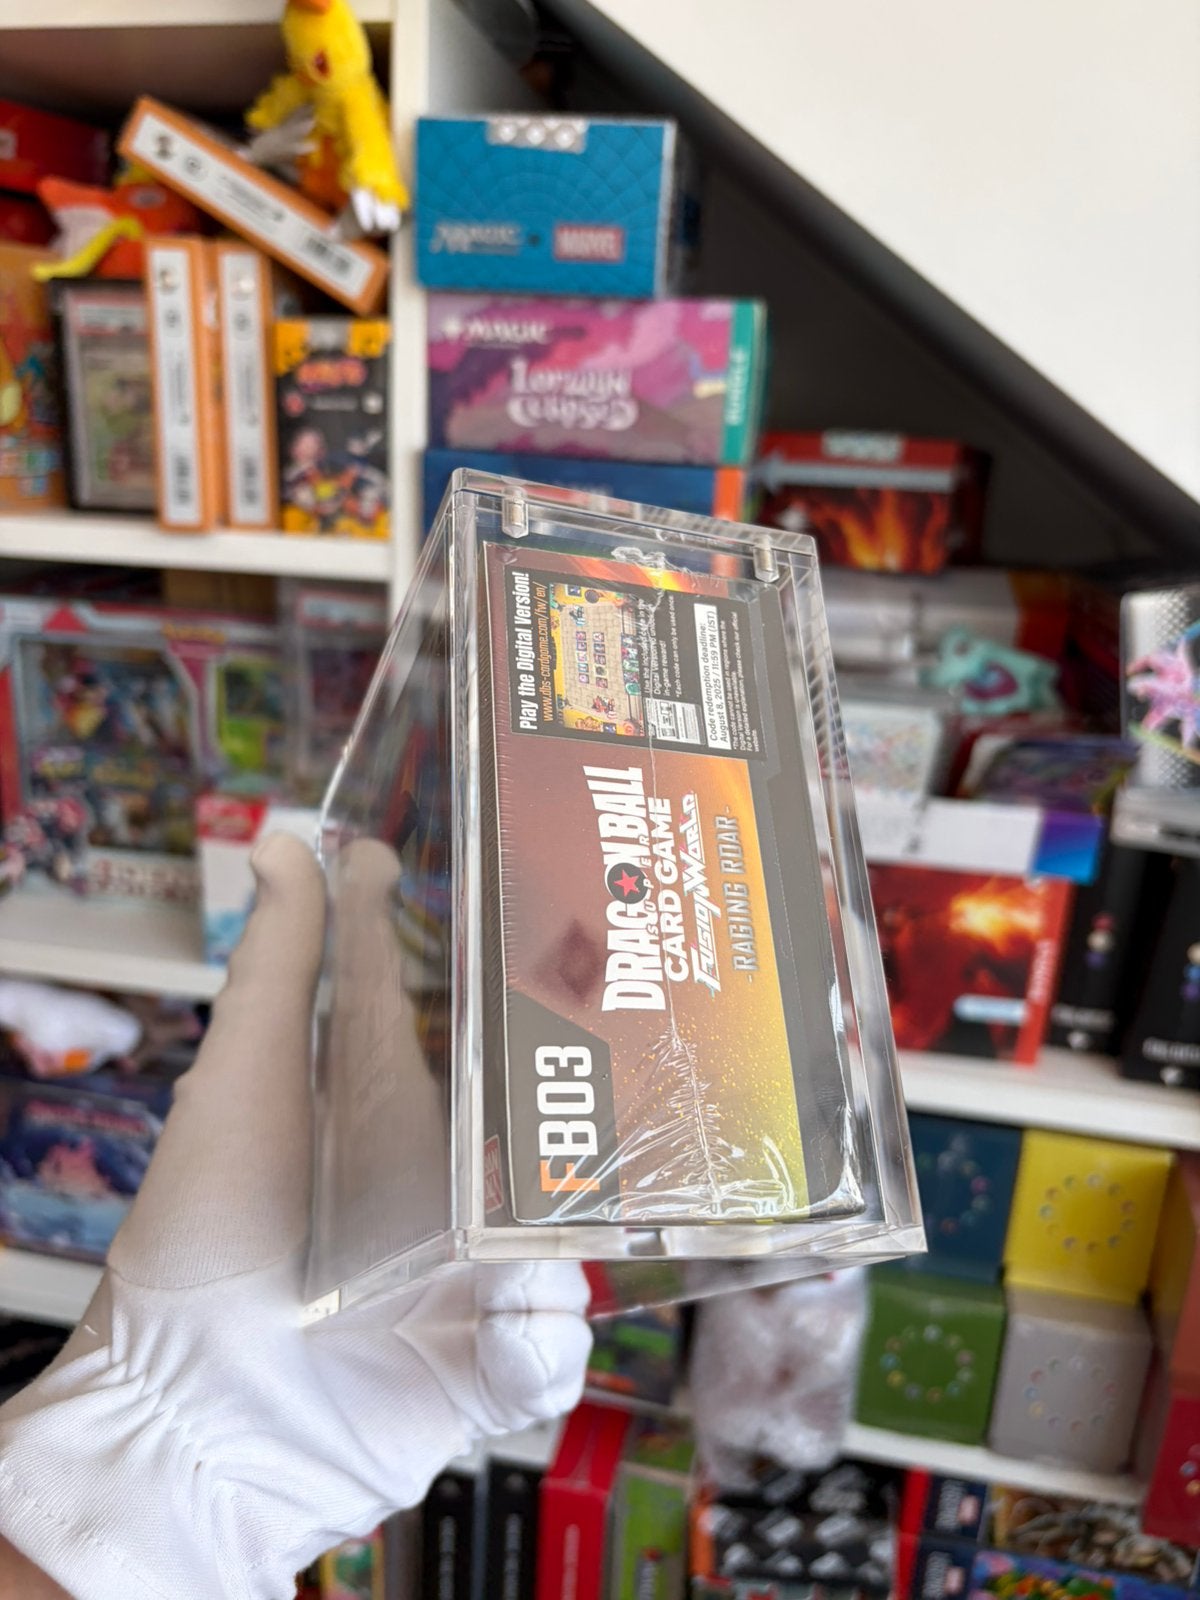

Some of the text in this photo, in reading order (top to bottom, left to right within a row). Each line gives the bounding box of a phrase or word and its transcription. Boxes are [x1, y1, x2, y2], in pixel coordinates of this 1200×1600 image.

[670, 628, 676, 636] be
[706, 611, 717, 632] (JST)
[512, 571, 538, 729] Play the Digital Version!
[533, 581, 553, 721] www.dbs-cardgame.com/fw/en/
[709, 634, 717, 648] PM
[659, 640, 672, 696] in-game reward!
[711, 650, 719, 670] 11:59
[652, 672, 662, 694] Digital
[699, 623, 718, 741] Code redemption deadline:
[712, 678, 722, 700] 2025
[716, 702, 724, 710] 8,
[717, 712, 728, 742] August
[742, 713, 750, 736] detailed
[583, 766, 666, 1011] DRAGON BALL
[638, 836, 659, 936] SUPER
[648, 797, 689, 981] CARD GAME
[535, 1046, 600, 1192] FB03
